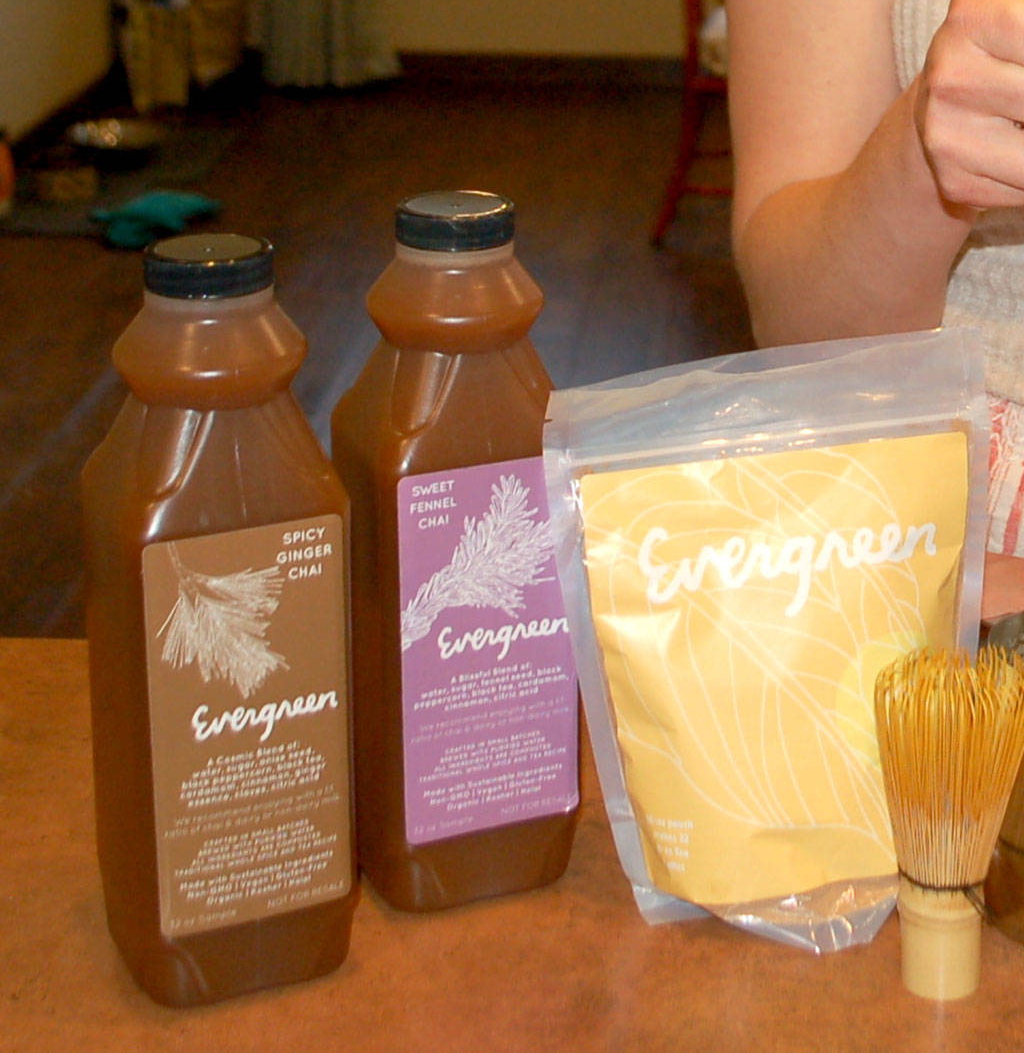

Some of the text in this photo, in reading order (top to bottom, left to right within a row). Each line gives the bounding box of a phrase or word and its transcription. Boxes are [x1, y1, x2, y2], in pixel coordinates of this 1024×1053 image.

[412, 480, 455, 496] SWEET
[410, 497, 457, 514] FENNEL
[418, 514, 449, 529] CHAI
[283, 527, 326, 545] SPICY
[276, 543, 332, 563] GINGER
[288, 563, 322, 579] CHAI
[637, 522, 937, 617] Evergreen
[437, 617, 570, 660] Evergreen
[192, 691, 338, 741] Evergreen
